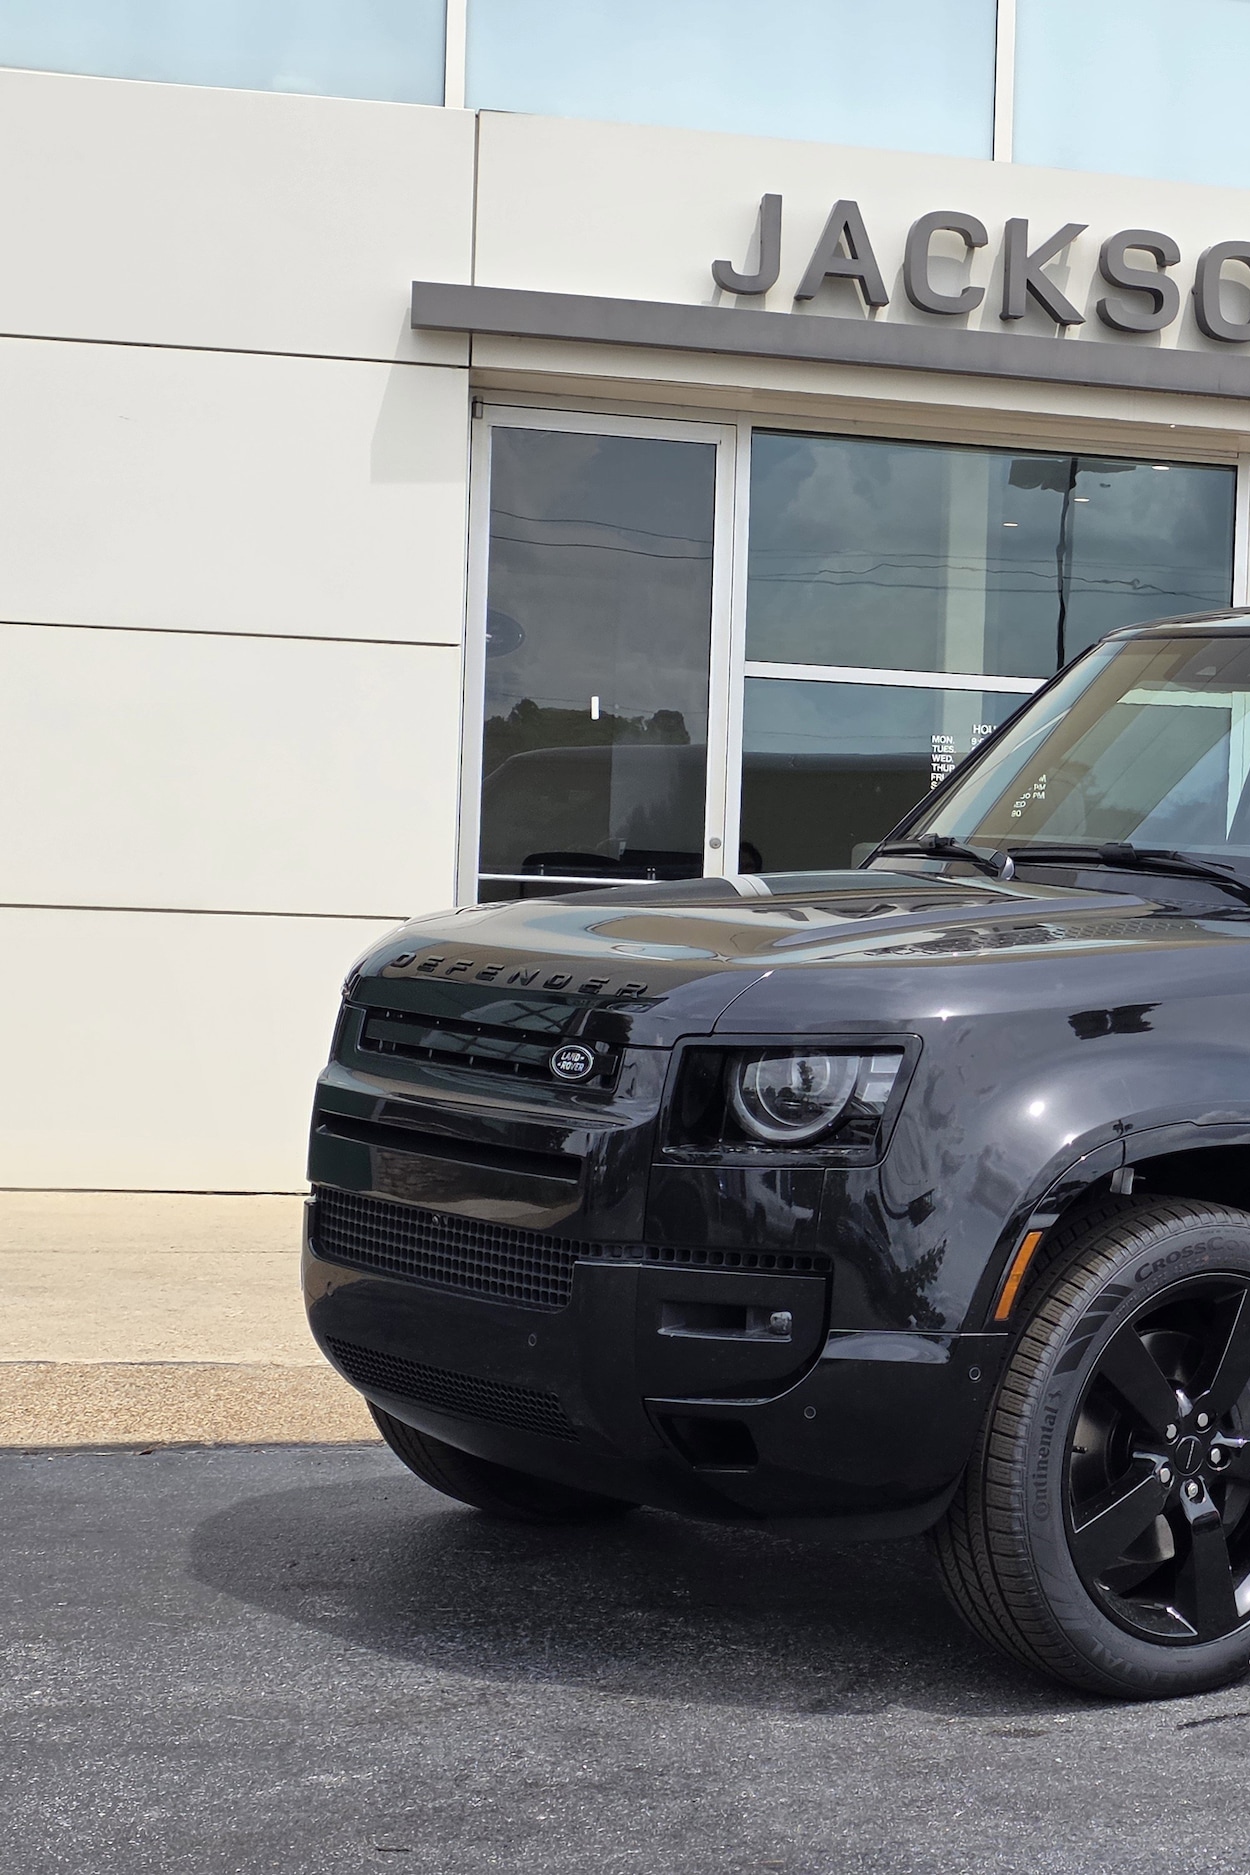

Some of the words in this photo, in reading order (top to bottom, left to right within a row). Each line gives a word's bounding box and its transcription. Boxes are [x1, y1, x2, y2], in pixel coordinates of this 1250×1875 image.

[931, 735, 955, 744] MON.
[931, 744, 956, 753] TUES.
[390, 952, 648, 998] DEFENDER
